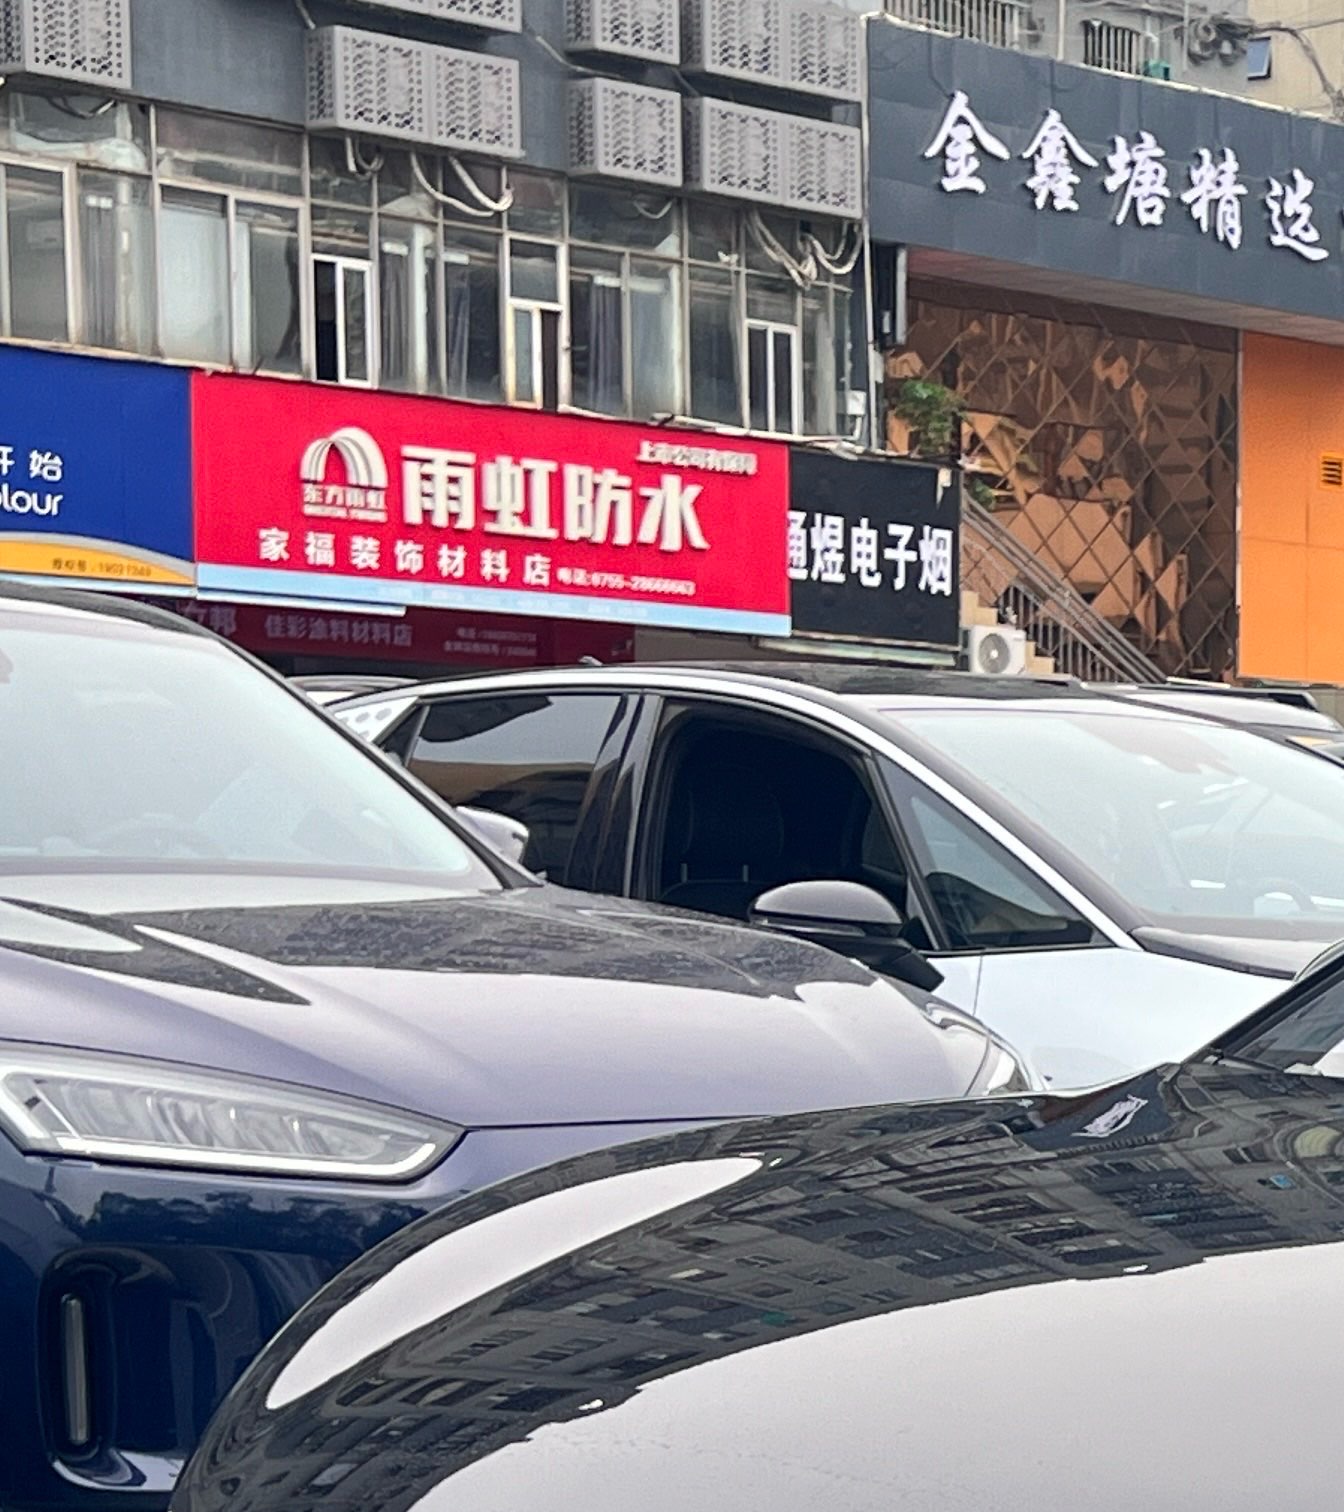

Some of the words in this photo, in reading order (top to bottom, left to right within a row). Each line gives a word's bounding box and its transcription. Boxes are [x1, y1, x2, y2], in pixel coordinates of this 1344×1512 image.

[0, 483, 63, 516] lour
[401, 445, 710, 552] 雨虹防水
[258, 528, 552, 587] 家福装饰材料店
